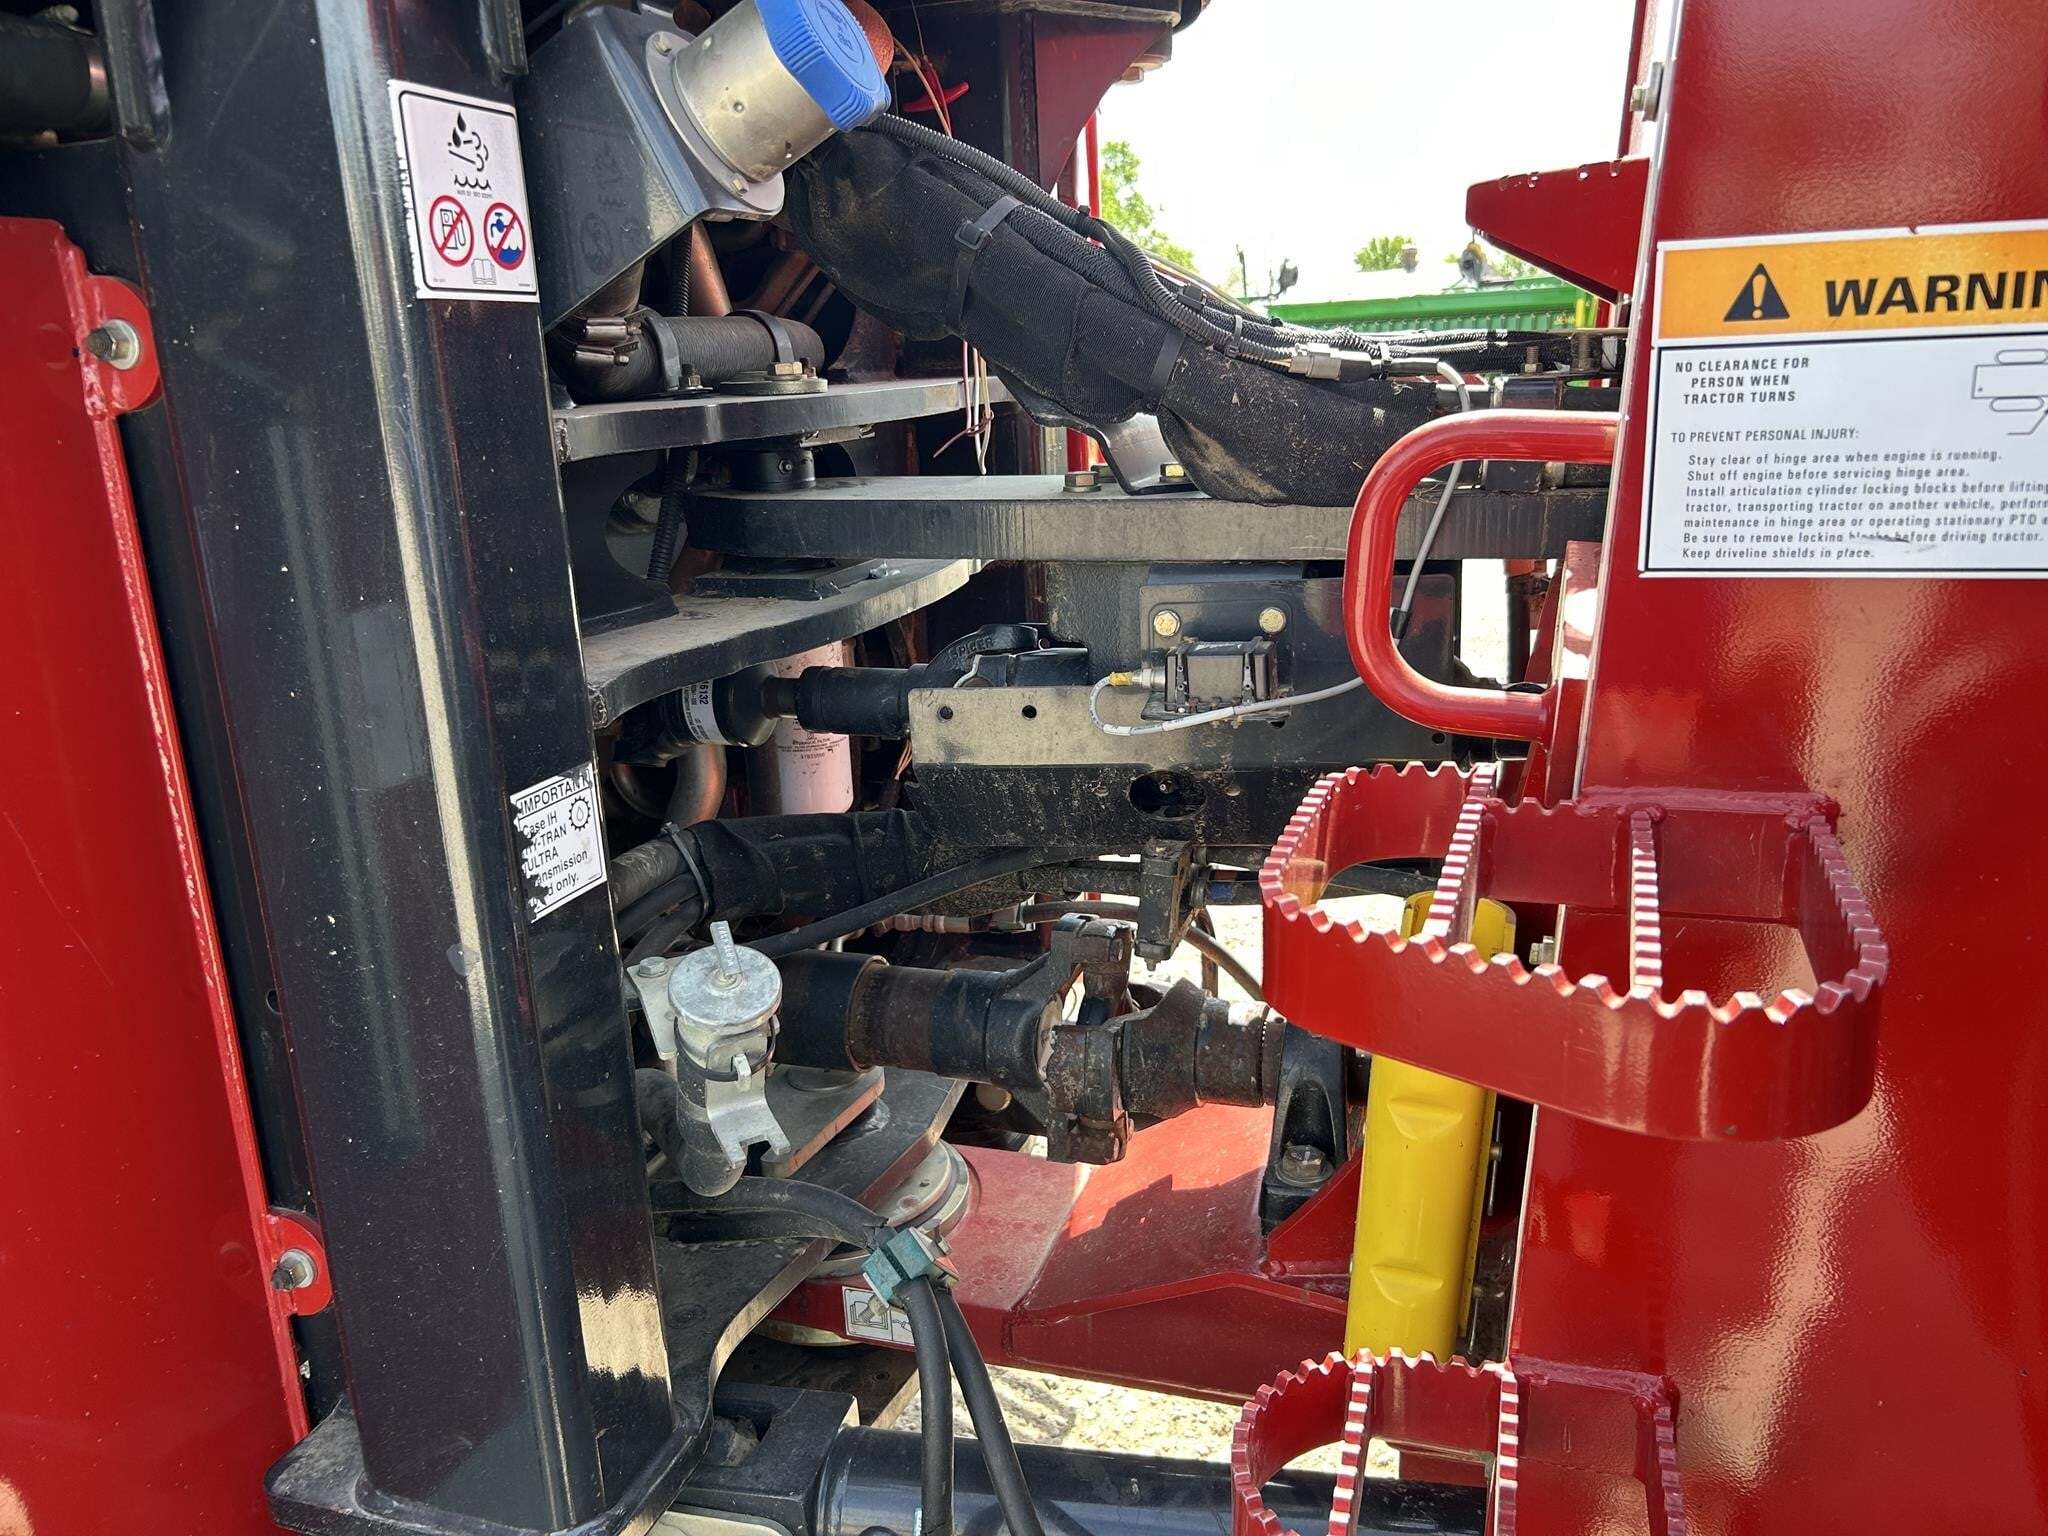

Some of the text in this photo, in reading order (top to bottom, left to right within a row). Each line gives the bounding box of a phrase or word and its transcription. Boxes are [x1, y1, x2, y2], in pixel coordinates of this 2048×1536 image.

[1675, 357, 1810, 373] NO CLEARANCE FOR
[1691, 374, 1790, 388] PERSON WHEN
[1683, 391, 1796, 405] TRACTOR TURNS
[1671, 428, 1860, 443] TO PREVENT PERSONAL INJURY:
[1688, 450, 2002, 468] Stay clear of hinge area when engine is running.
[1687, 466, 1970, 482] Shut off engine before servicing hinge area.
[1686, 486, 1725, 497] Install
[1729, 485, 1802, 497] articulation
[1807, 484, 1857, 498] cylinder
[1862, 483, 1909, 496] locking
[1914, 482, 1957, 494] blocks
[1962, 481, 2004, 493] before
[1685, 502, 1731, 514] tractor,
[1737, 500, 1813, 514] transporting
[1819, 501, 1862, 511] tractor
[1868, 501, 1883, 510] on
[1889, 499, 1939, 510] another
[1944, 498, 1995, 511] vehicle,
[1684, 517, 1759, 528] maintenance
[1764, 517, 1775, 527] in
[1780, 516, 1813, 529] hinge
[1818, 517, 1846, 527] area
[1851, 517, 1863, 527] or
[1869, 516, 1930, 529] operating
[1936, 515, 2004, 528] stationary
[2009, 514, 2037, 525] PTO
[1683, 533, 1697, 543] Be
[1702, 533, 1728, 543] sure
[1733, 533, 1745, 543] to
[1750, 533, 1793, 543] remove
[1941, 531, 1987, 544] driving
[1682, 547, 1874, 560] Keep driveline shields in place.
[523, 809, 558, 838] Case IH
[528, 845, 559, 871] ULTRA
[535, 850, 588, 885] ansmission
[556, 872, 579, 892] only.
